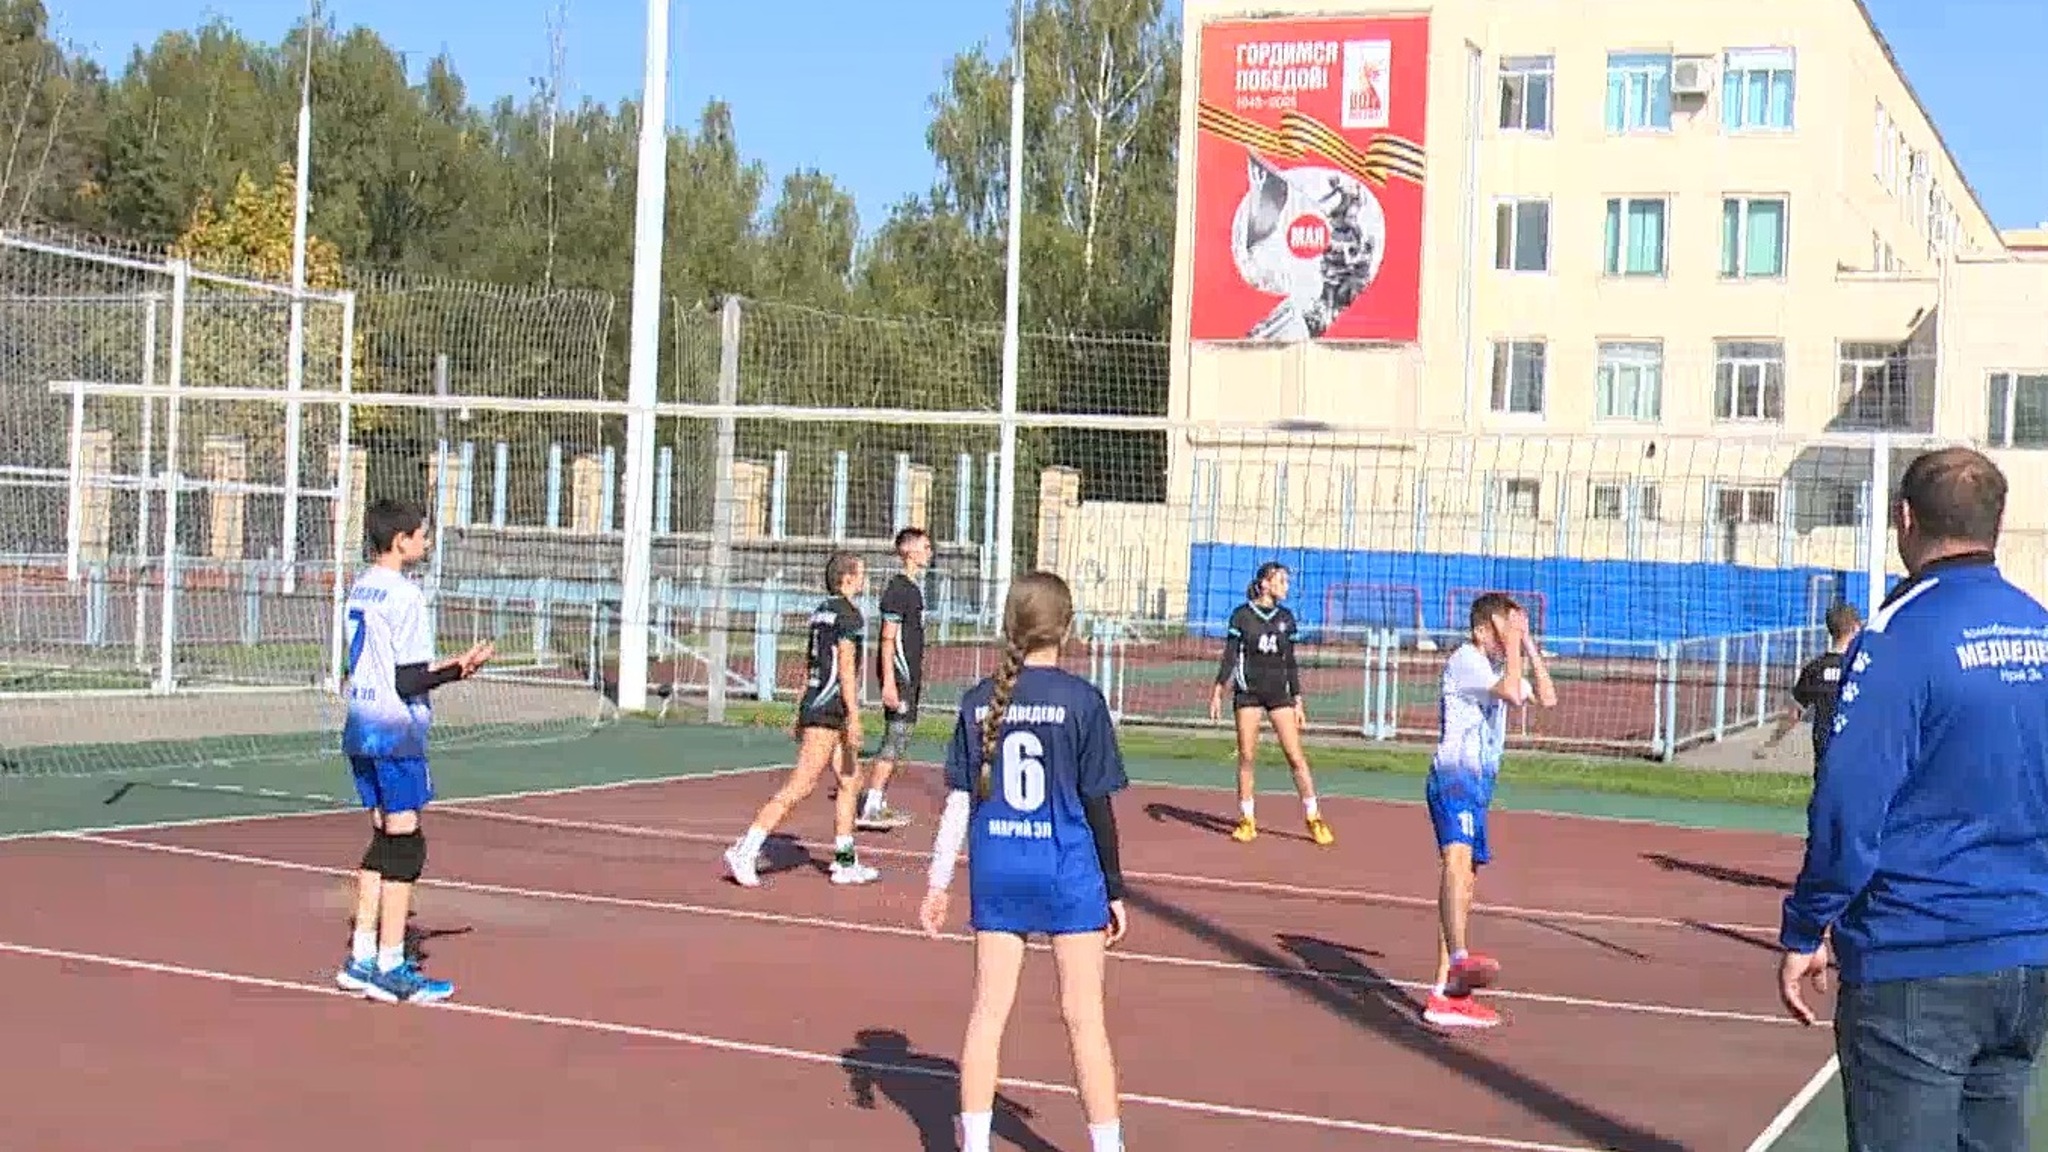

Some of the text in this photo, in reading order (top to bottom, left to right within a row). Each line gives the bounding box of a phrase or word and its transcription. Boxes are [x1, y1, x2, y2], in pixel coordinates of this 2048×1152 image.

[1235, 41, 1338, 66] ГОРДИМСЯ
[349, 609, 365, 674] 7
[1002, 730, 1046, 812] 6
[1033, 820, 1053, 839] ЭЛ
